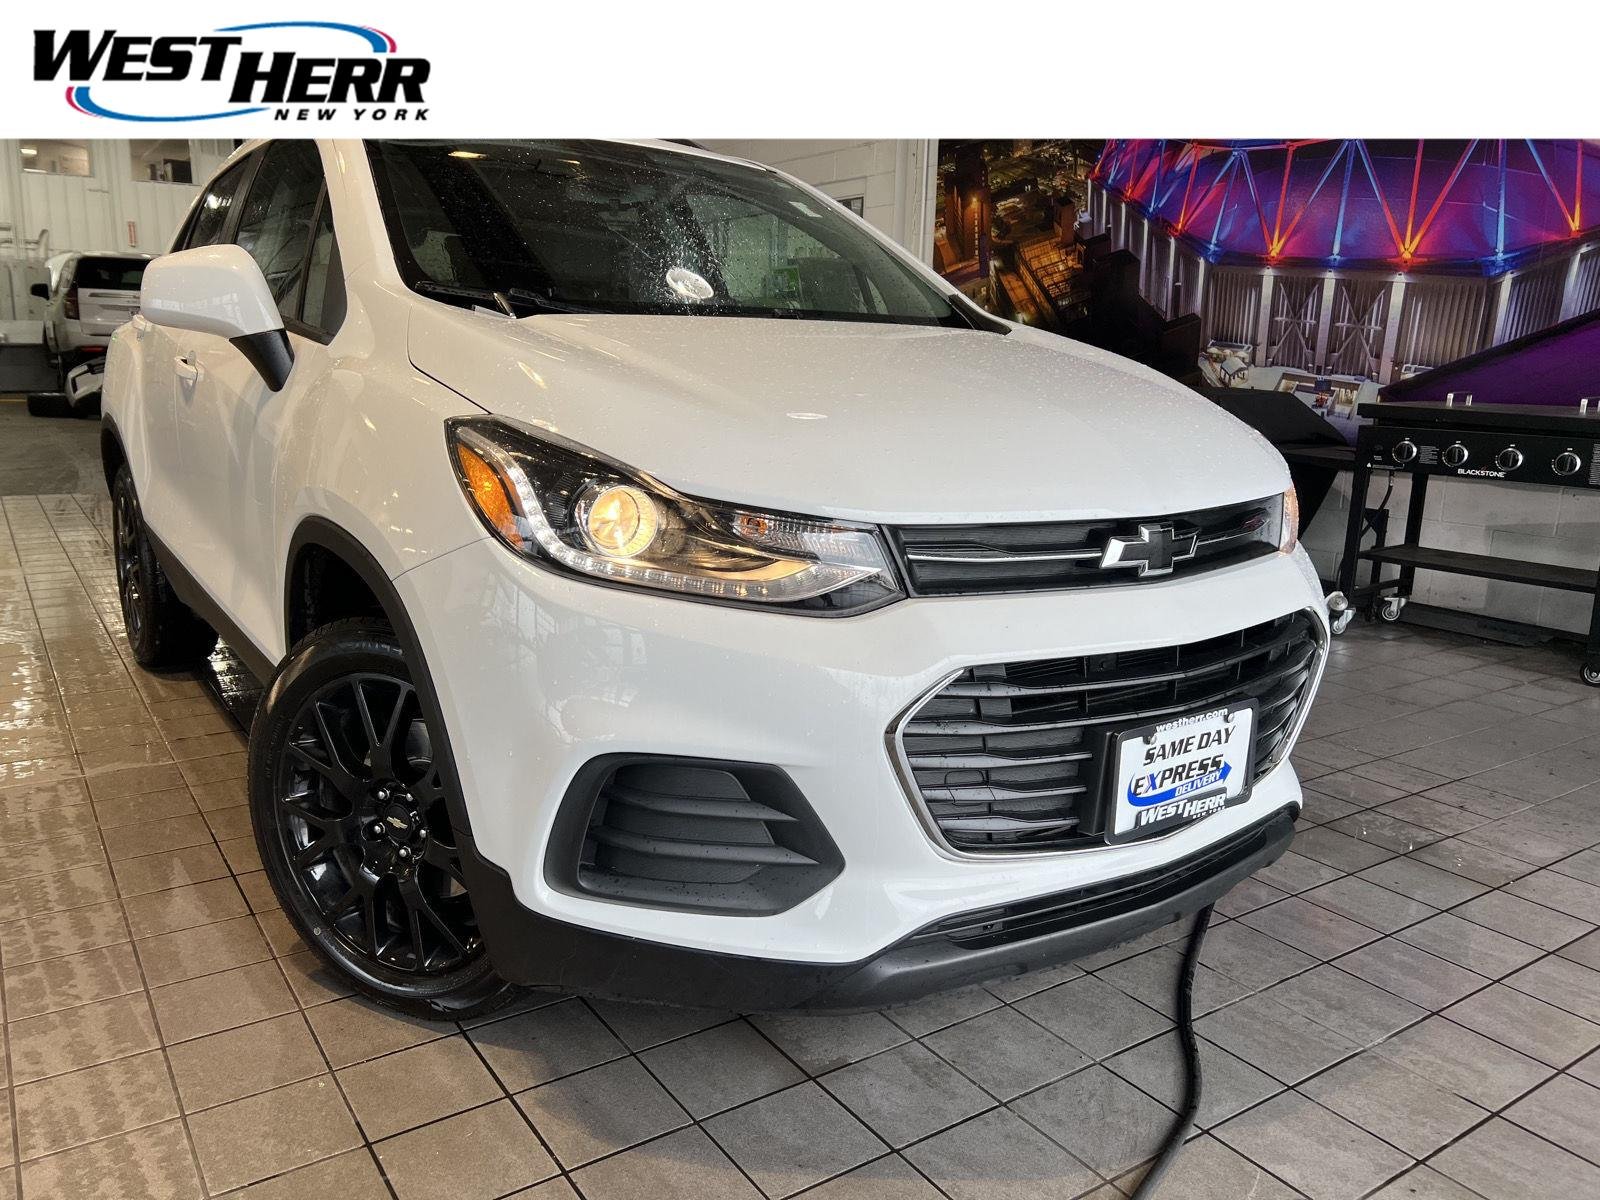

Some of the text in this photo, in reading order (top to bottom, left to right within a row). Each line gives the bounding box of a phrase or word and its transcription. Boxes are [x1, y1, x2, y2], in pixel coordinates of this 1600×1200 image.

[1457, 468, 1505, 478] BLACKSTONE
[1155, 708, 1228, 732] westherr.com
[1143, 725, 1236, 767] SAME DAY
[1133, 754, 1224, 796] EXPRESS
[1175, 769, 1222, 797] DELIVERY
